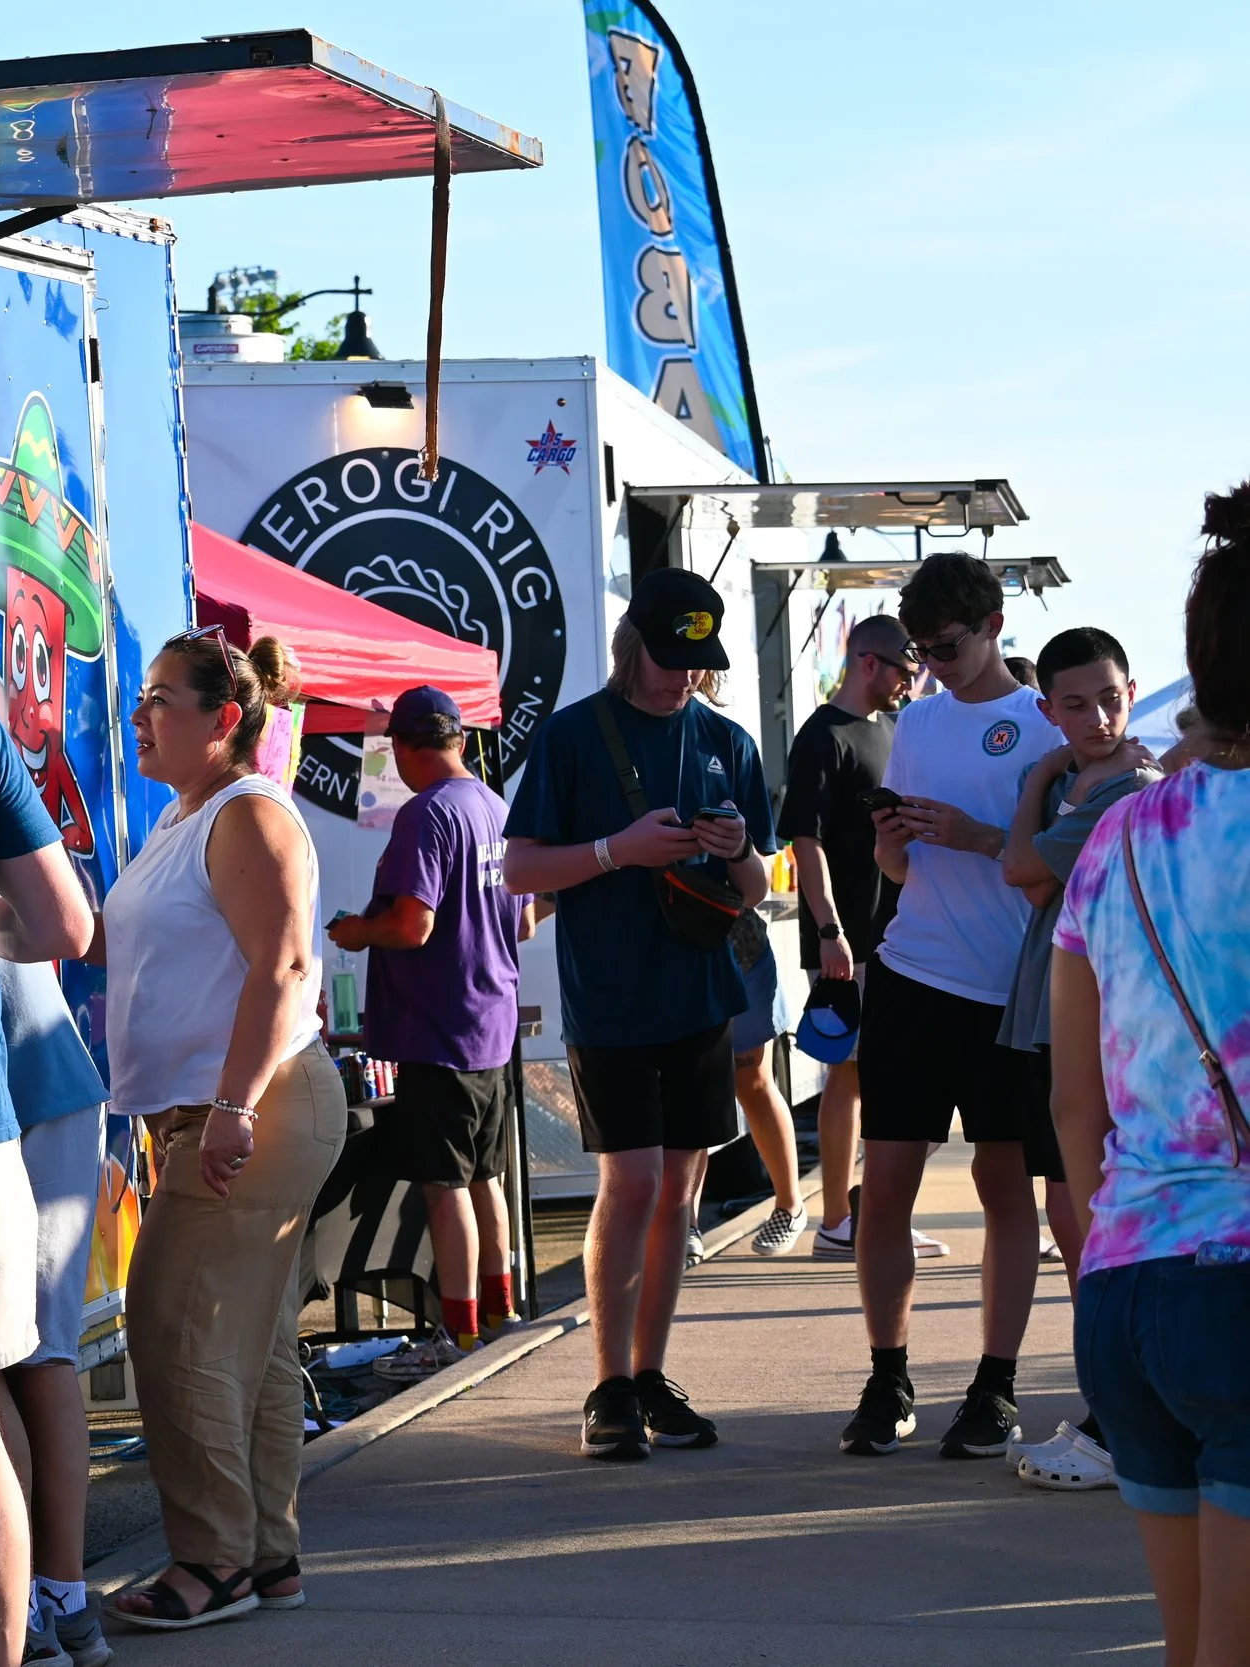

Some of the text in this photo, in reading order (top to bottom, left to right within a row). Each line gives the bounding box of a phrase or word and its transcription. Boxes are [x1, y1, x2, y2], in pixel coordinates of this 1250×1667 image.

[527, 447, 577, 462] CARGO
[248, 457, 552, 611] EROGI RIG
[296, 690, 544, 801] ERN TCHEN
